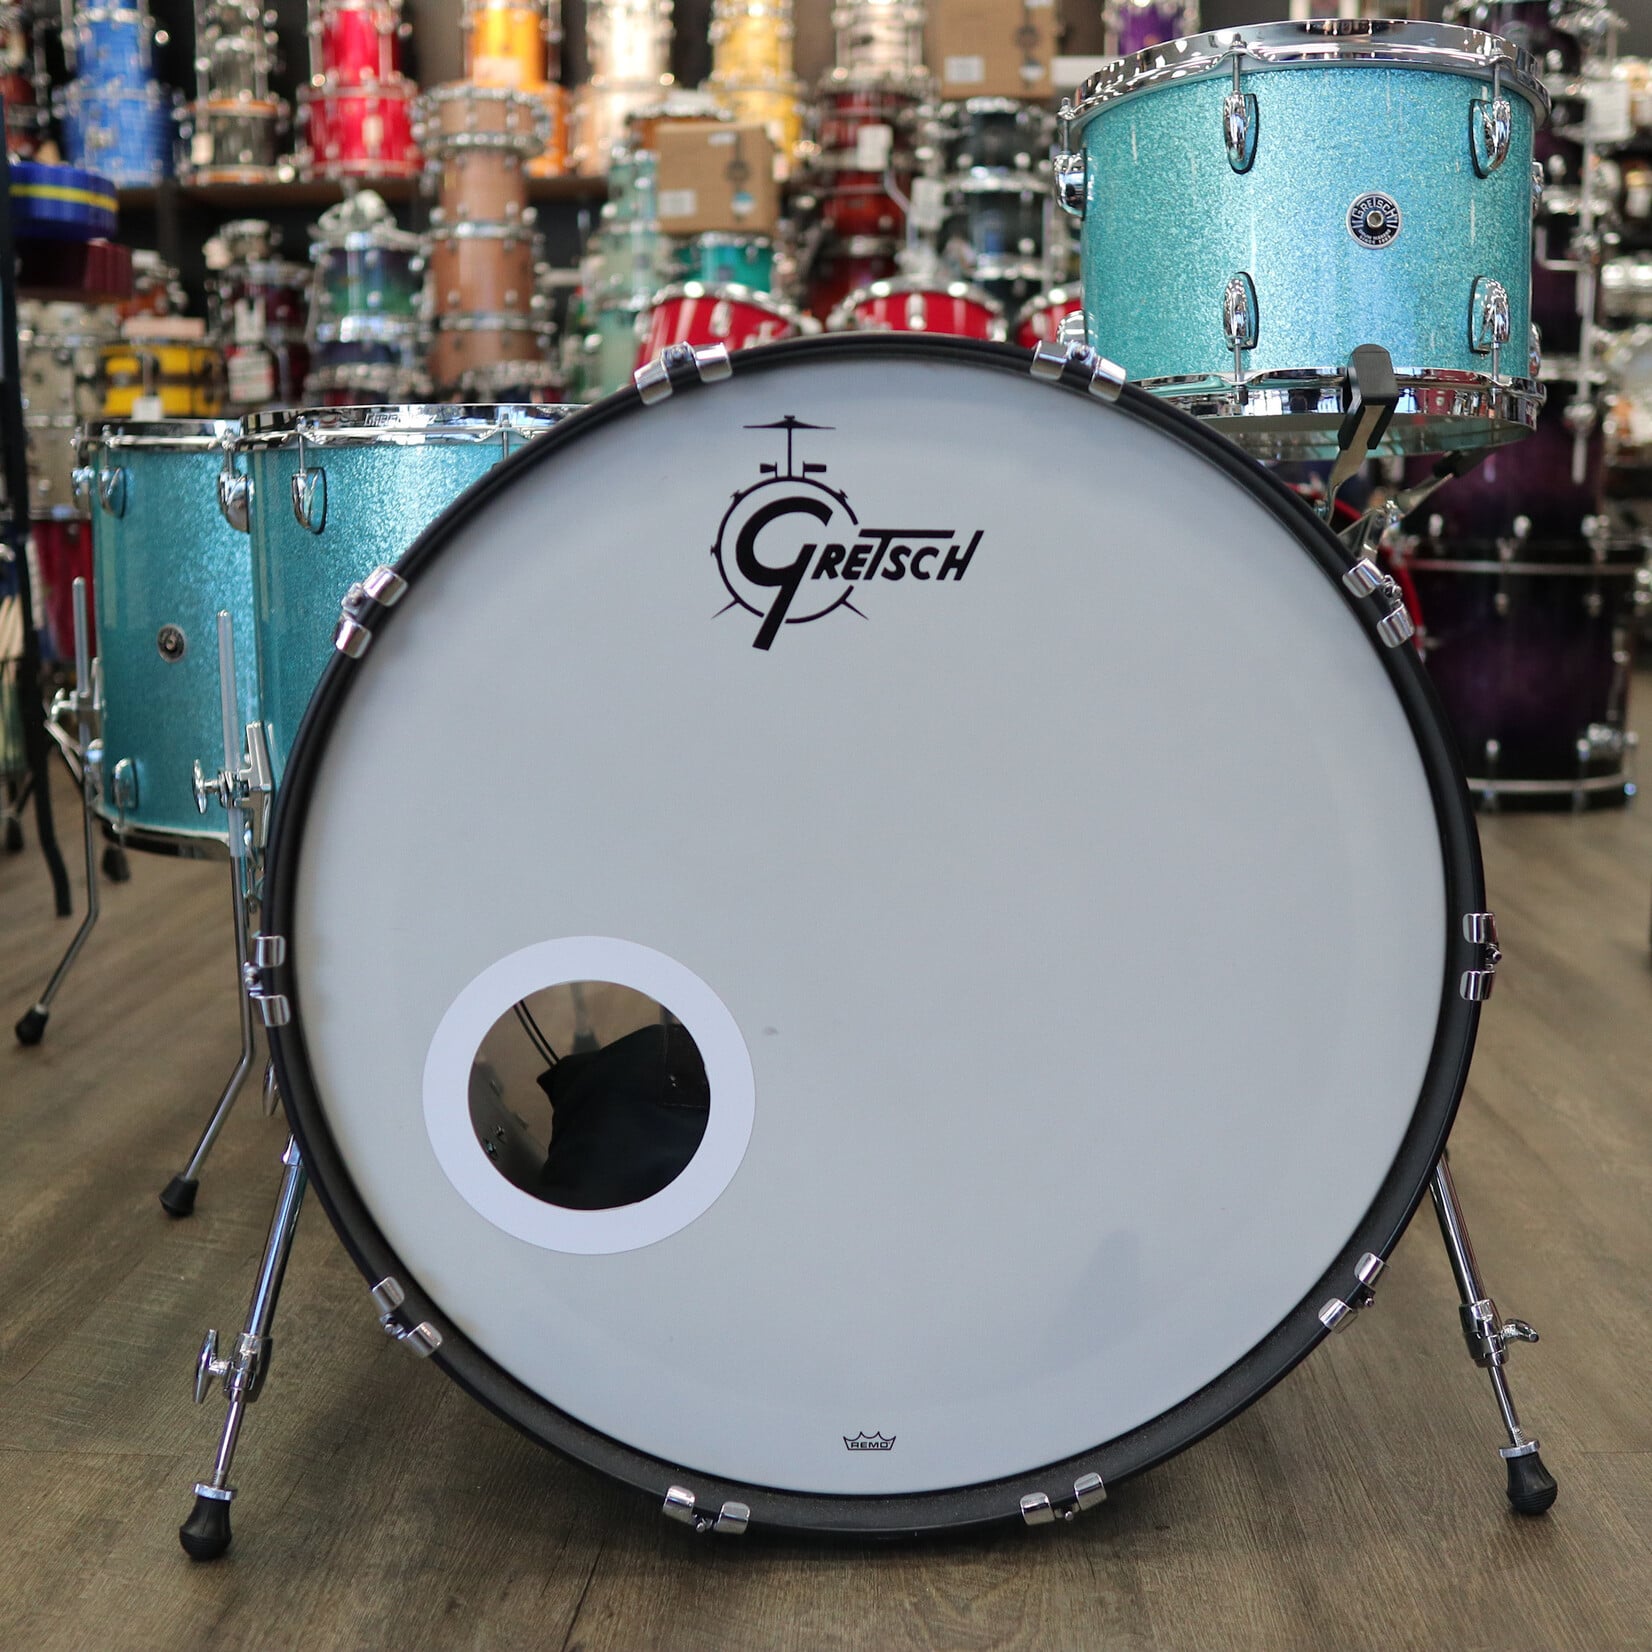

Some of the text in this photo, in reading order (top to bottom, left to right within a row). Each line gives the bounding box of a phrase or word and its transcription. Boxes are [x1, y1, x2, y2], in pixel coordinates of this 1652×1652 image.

[1351, 195, 1398, 219] GRETSCH
[735, 496, 985, 651] GRETSCH
[850, 1441, 889, 1449] REMO
